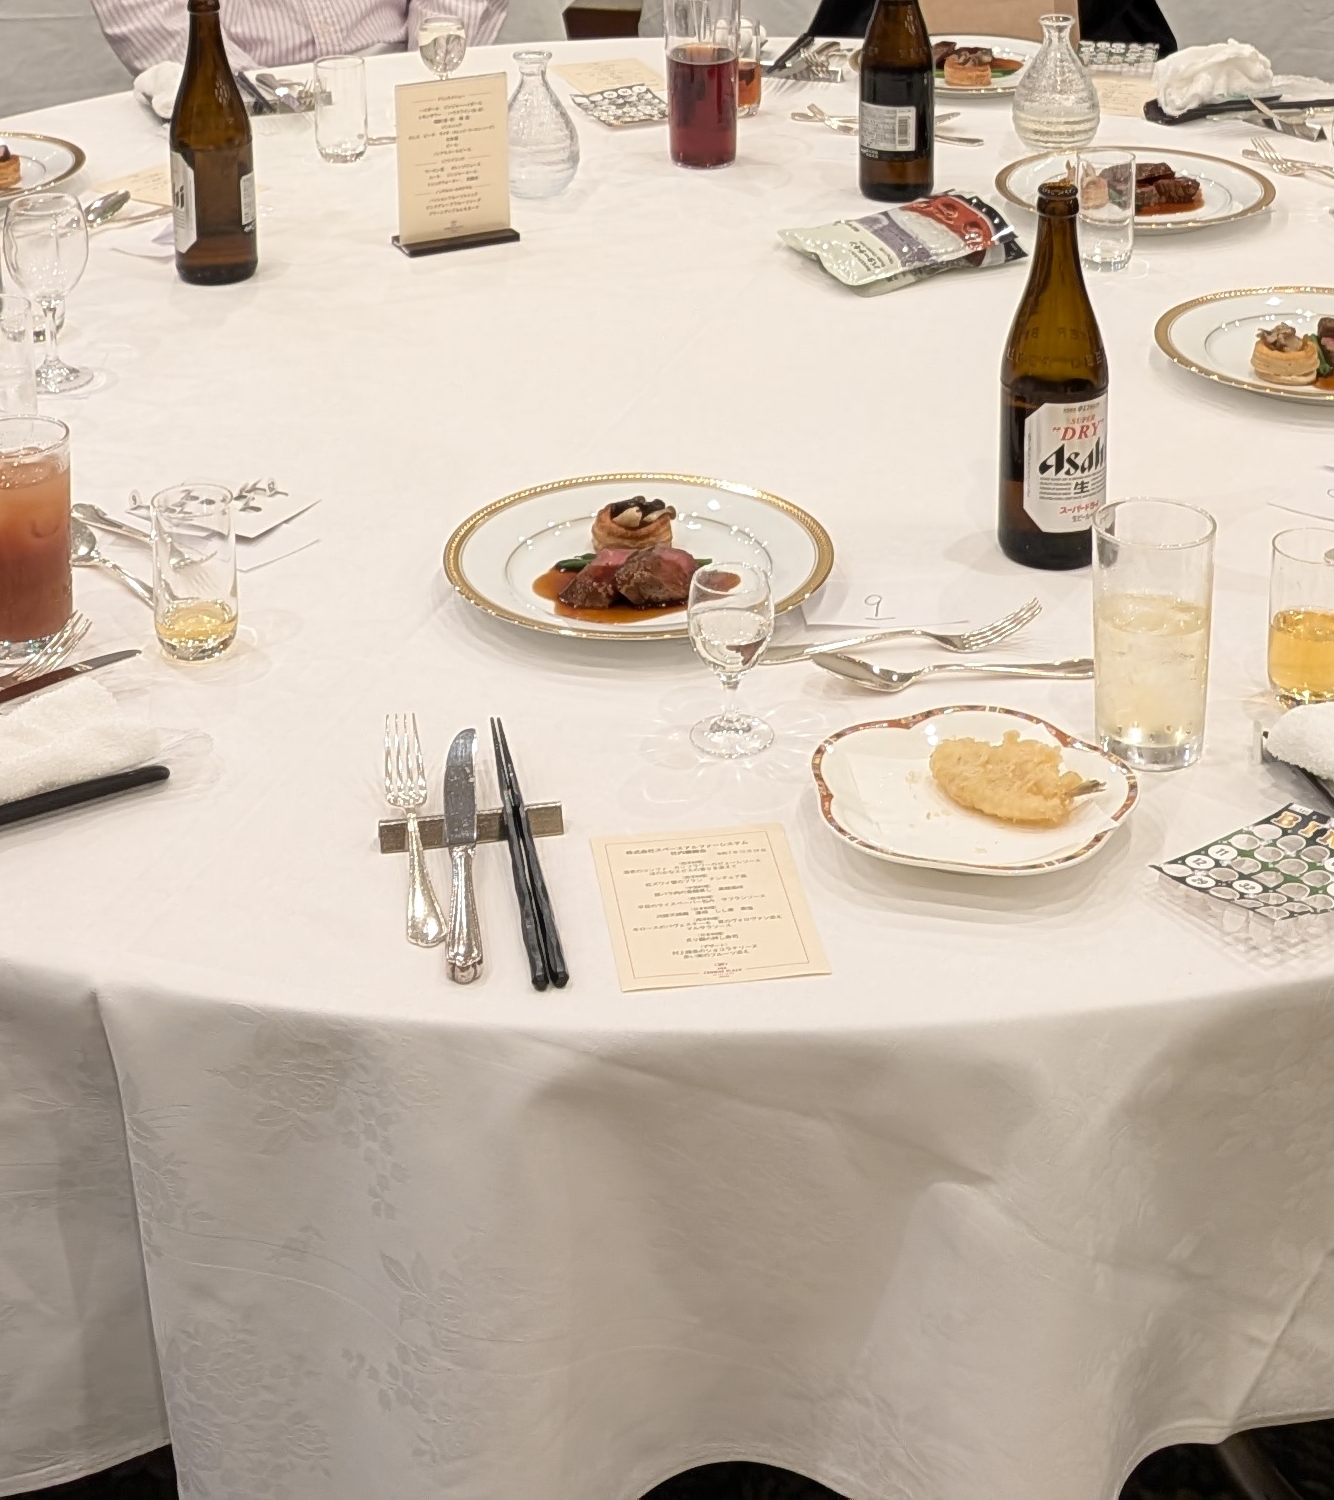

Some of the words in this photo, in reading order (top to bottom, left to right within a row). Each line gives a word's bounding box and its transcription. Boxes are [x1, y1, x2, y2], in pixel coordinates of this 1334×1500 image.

[1070, 413, 1096, 425] SUPER
[1073, 480, 1091, 495] 生
[1059, 500, 1101, 515] スーパードライ
[1214, 848, 1231, 857] 11
[1192, 857, 1209, 867] 12
